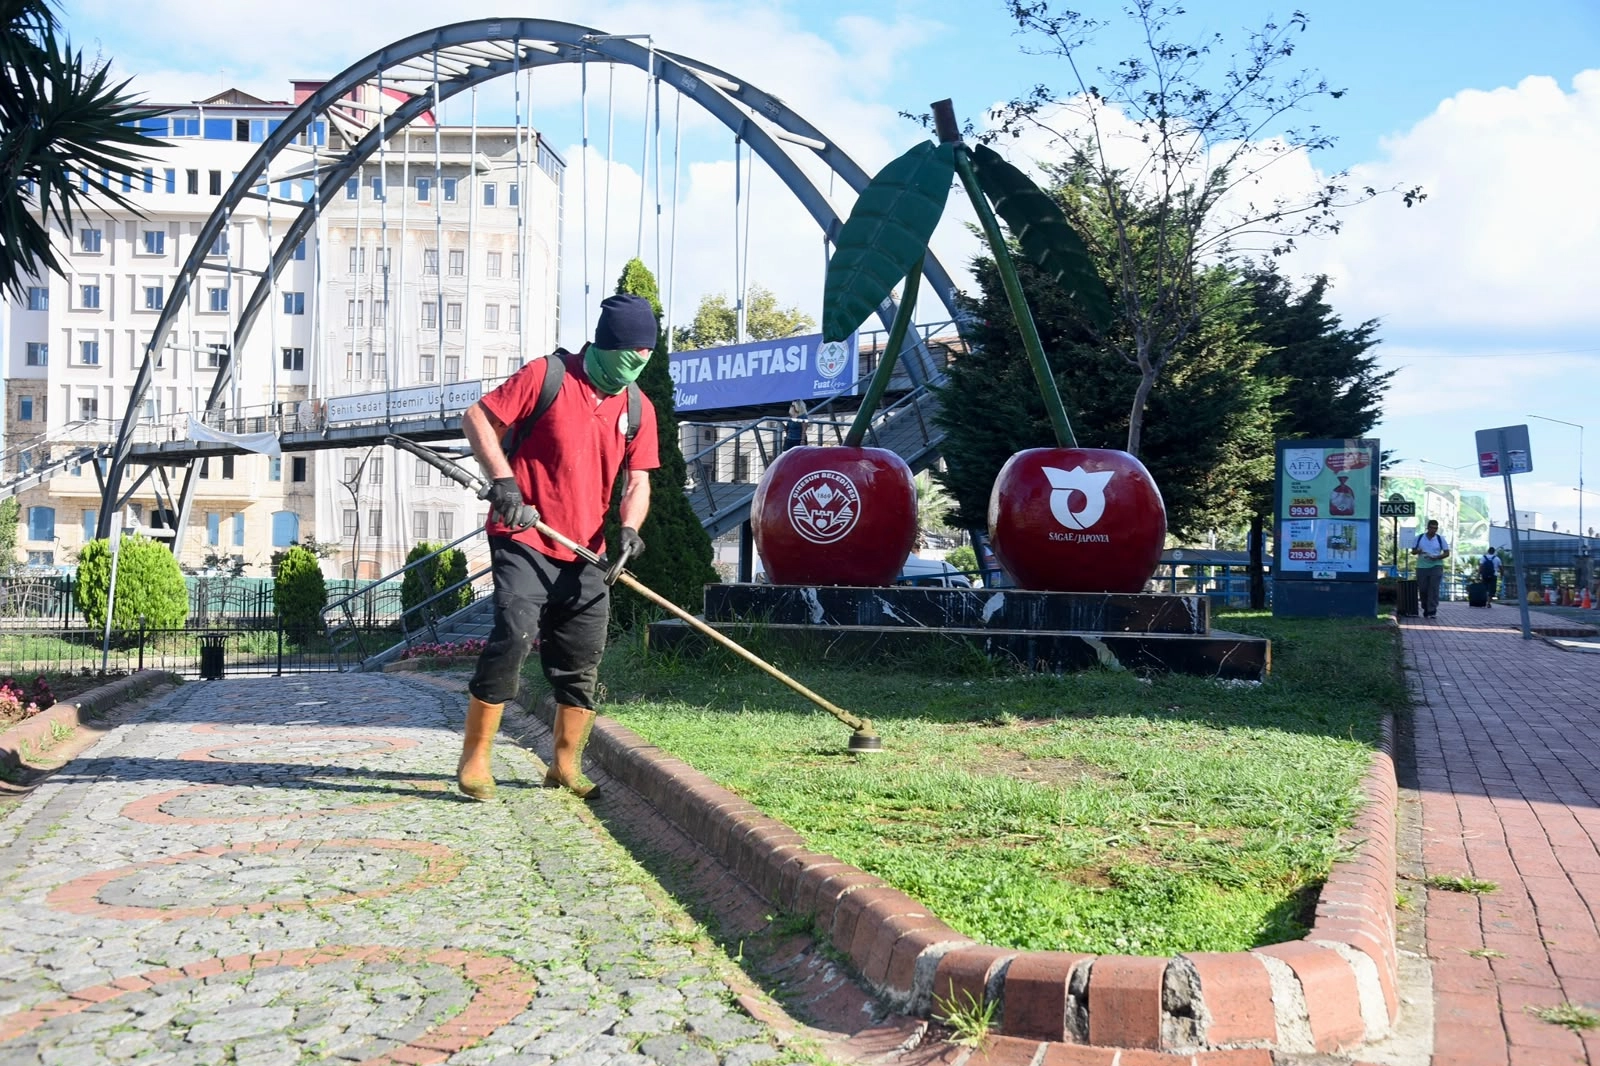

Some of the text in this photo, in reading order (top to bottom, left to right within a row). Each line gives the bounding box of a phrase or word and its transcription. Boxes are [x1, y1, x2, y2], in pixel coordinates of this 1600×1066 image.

[717, 345, 807, 380] HAFTASI
[813, 380, 831, 389] Fuat
[330, 401, 353, 416] Şehit
[356, 401, 382, 412] Sedat
[448, 389, 479, 405] Geçidi
[1289, 462, 1320, 470] AFTA
[1290, 507, 1315, 515] 99.90
[1290, 551, 1316, 559] 219.90
